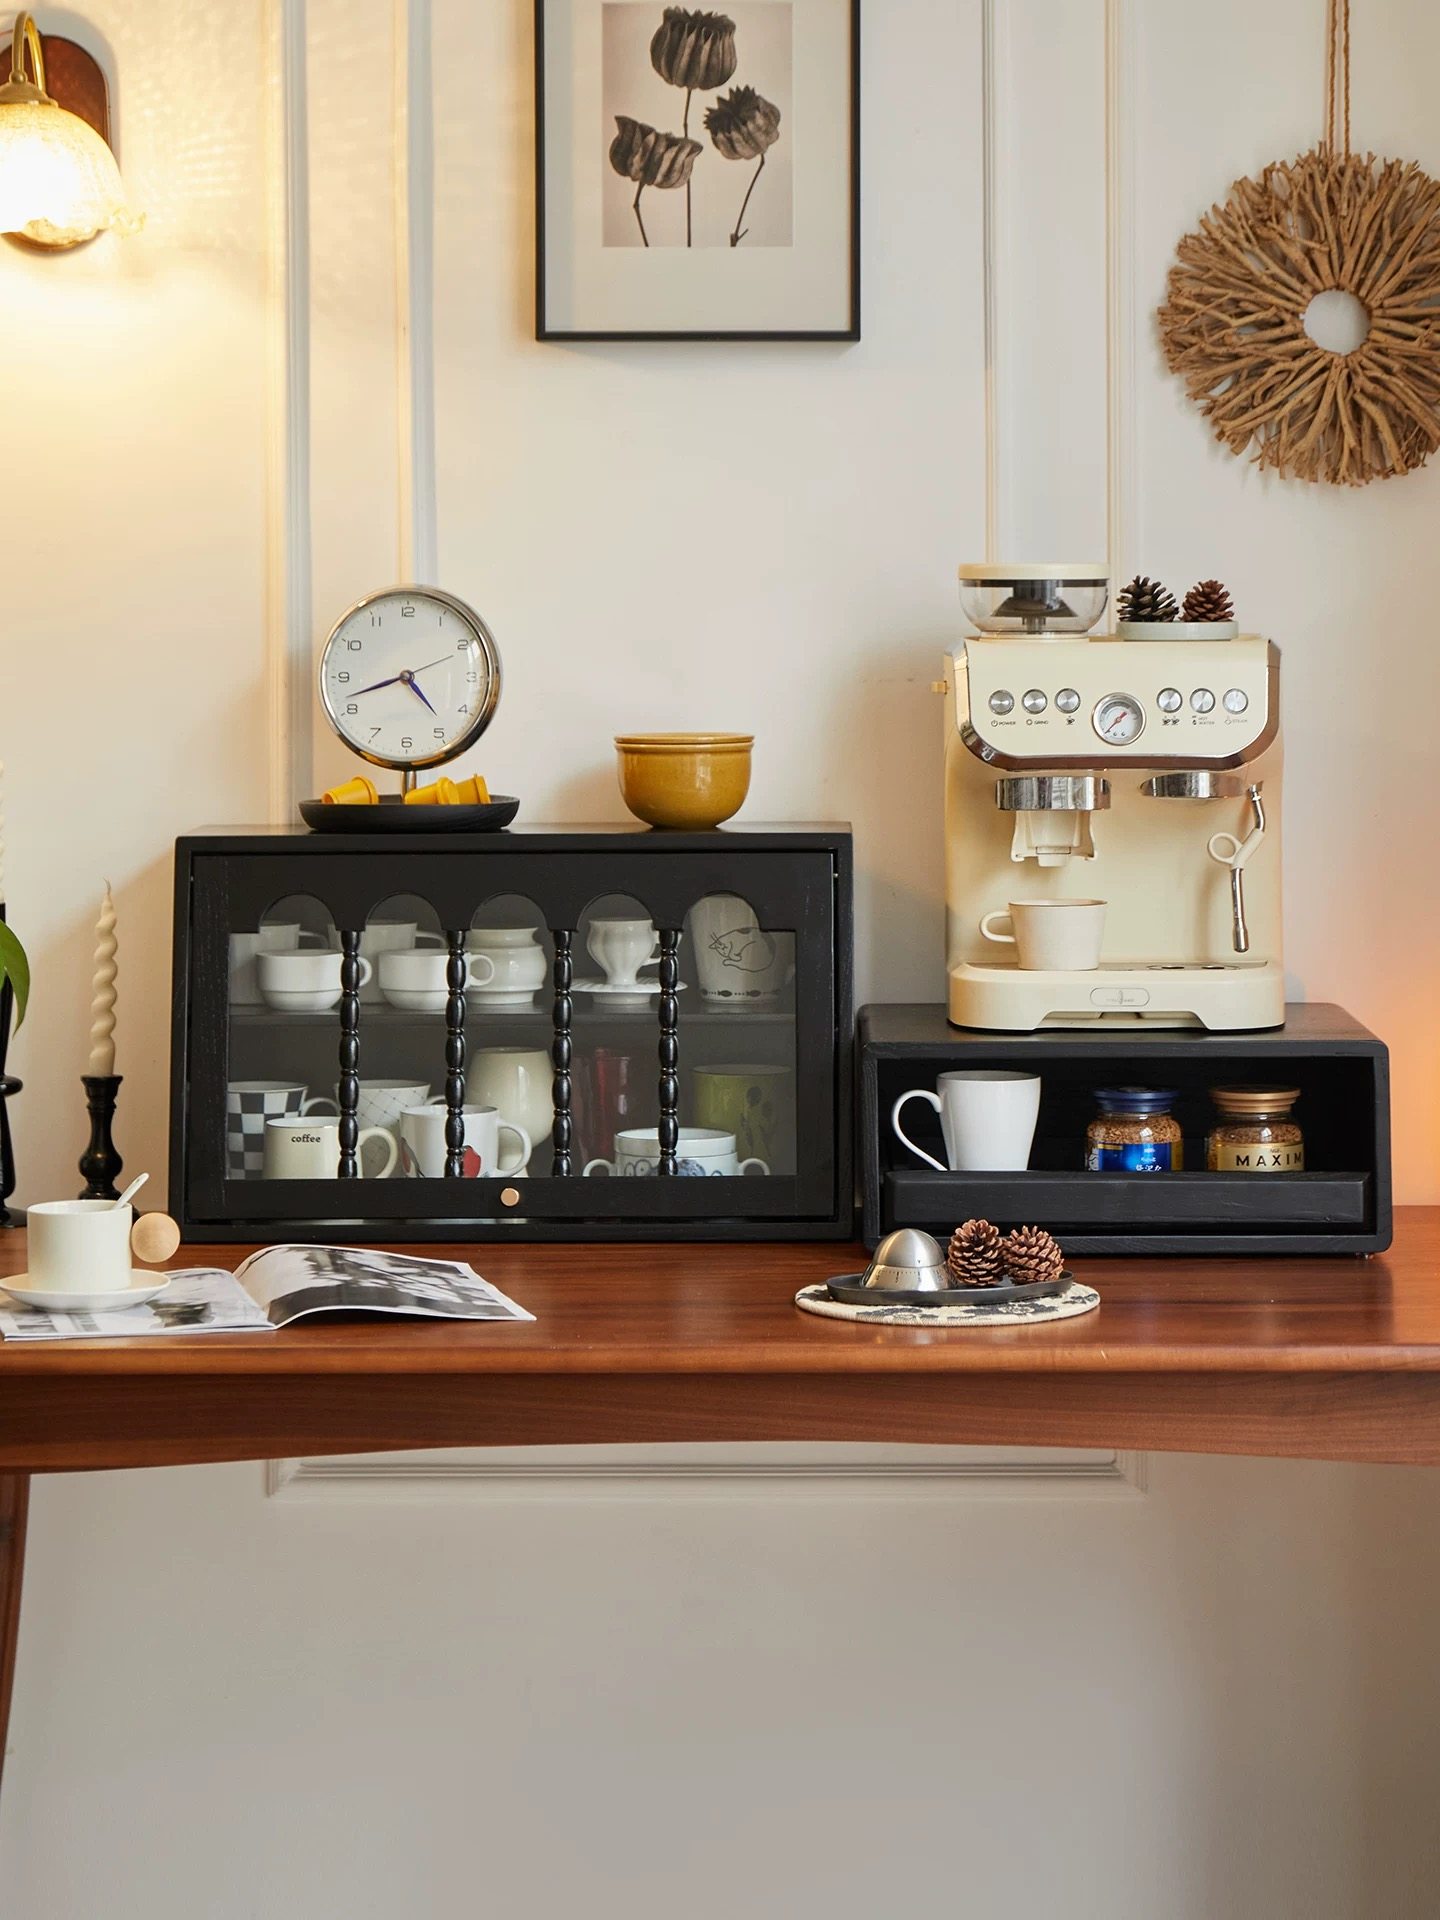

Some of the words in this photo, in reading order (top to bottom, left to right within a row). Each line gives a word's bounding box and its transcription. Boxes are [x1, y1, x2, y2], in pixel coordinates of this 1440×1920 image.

[401, 606, 415, 618] 12
[371, 616, 382, 627] 11
[347, 640, 362, 651] 10
[457, 639, 469, 650] 2
[338, 671, 350, 683] 9
[466, 671, 477, 683] 3
[346, 703, 358, 715] 8
[457, 704, 468, 713] 4
[369, 727, 382, 738] 7
[433, 727, 445, 739] 5
[401, 737, 413, 748] 6
[291, 1133, 321, 1143] coffee
